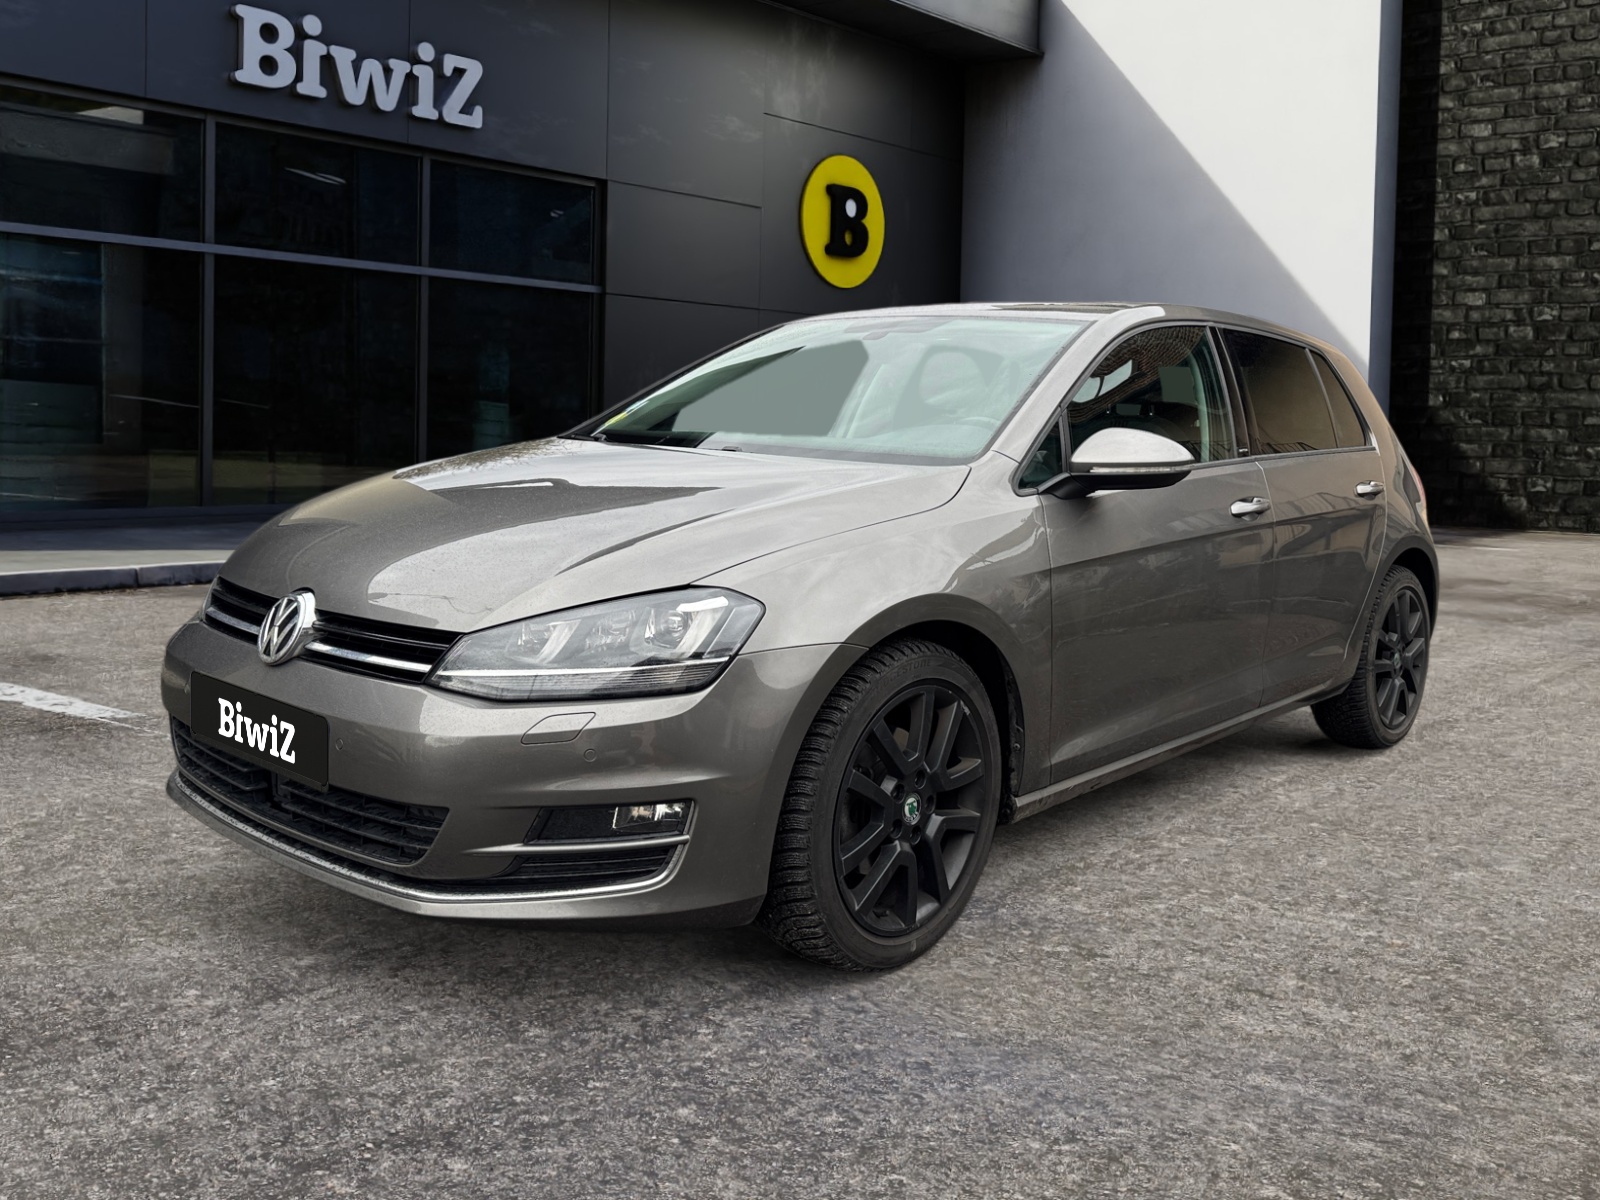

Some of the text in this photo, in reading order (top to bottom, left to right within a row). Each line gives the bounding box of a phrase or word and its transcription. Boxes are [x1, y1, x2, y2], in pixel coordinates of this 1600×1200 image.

[230, 3, 483, 129] BiwiZ
[824, 183, 870, 258] B
[217, 697, 296, 764] BiwiZ
